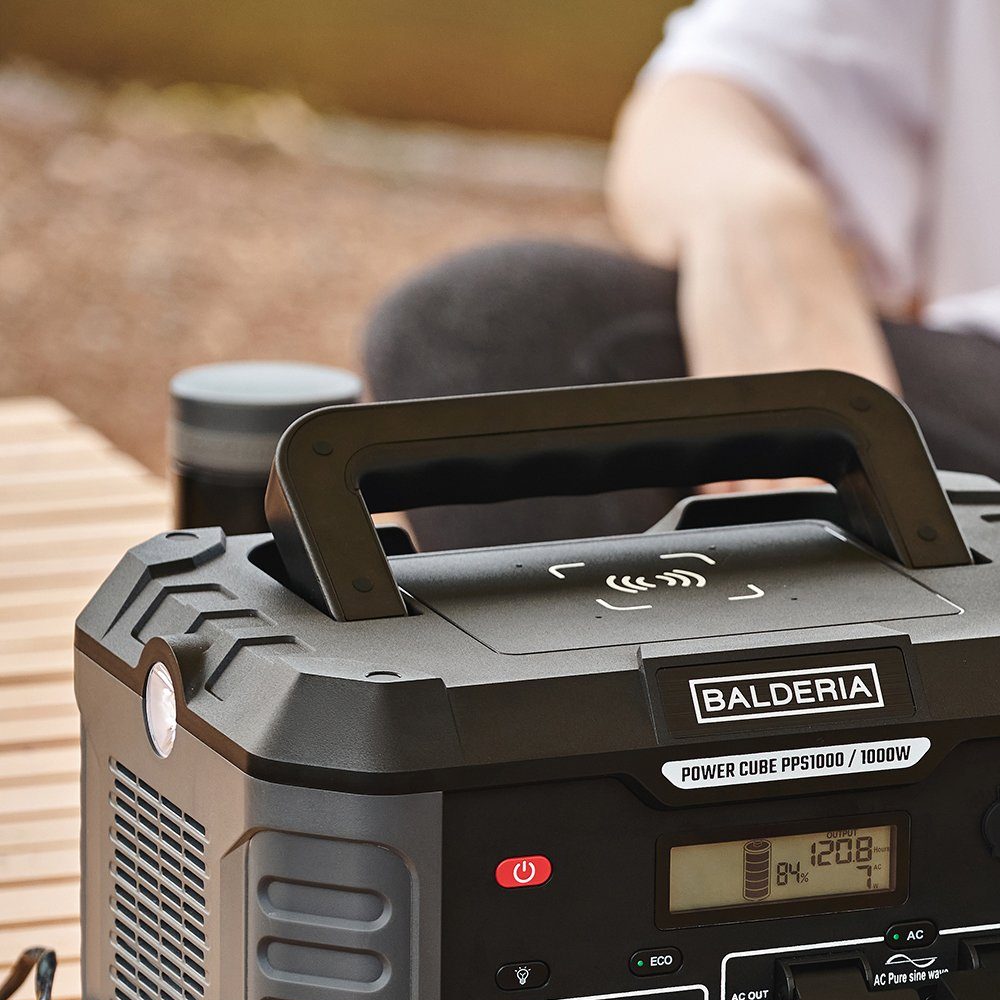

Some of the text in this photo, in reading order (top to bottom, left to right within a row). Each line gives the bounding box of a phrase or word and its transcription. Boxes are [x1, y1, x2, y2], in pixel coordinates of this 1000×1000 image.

[702, 675, 872, 713] BALDERIA
[681, 745, 911, 782] POWER CUBE PPS1000 / 1000W
[826, 829, 857, 839] OUTPUT
[811, 836, 873, 867] 120.8
[856, 865, 872, 889] 7
[906, 929, 924, 941] AC
[650, 955, 673, 966] ECO
[873, 973, 887, 987] AC
[887, 971, 908, 985] Pure
[909, 969, 926, 982] sine
[747, 989, 769, 1000] OUT
